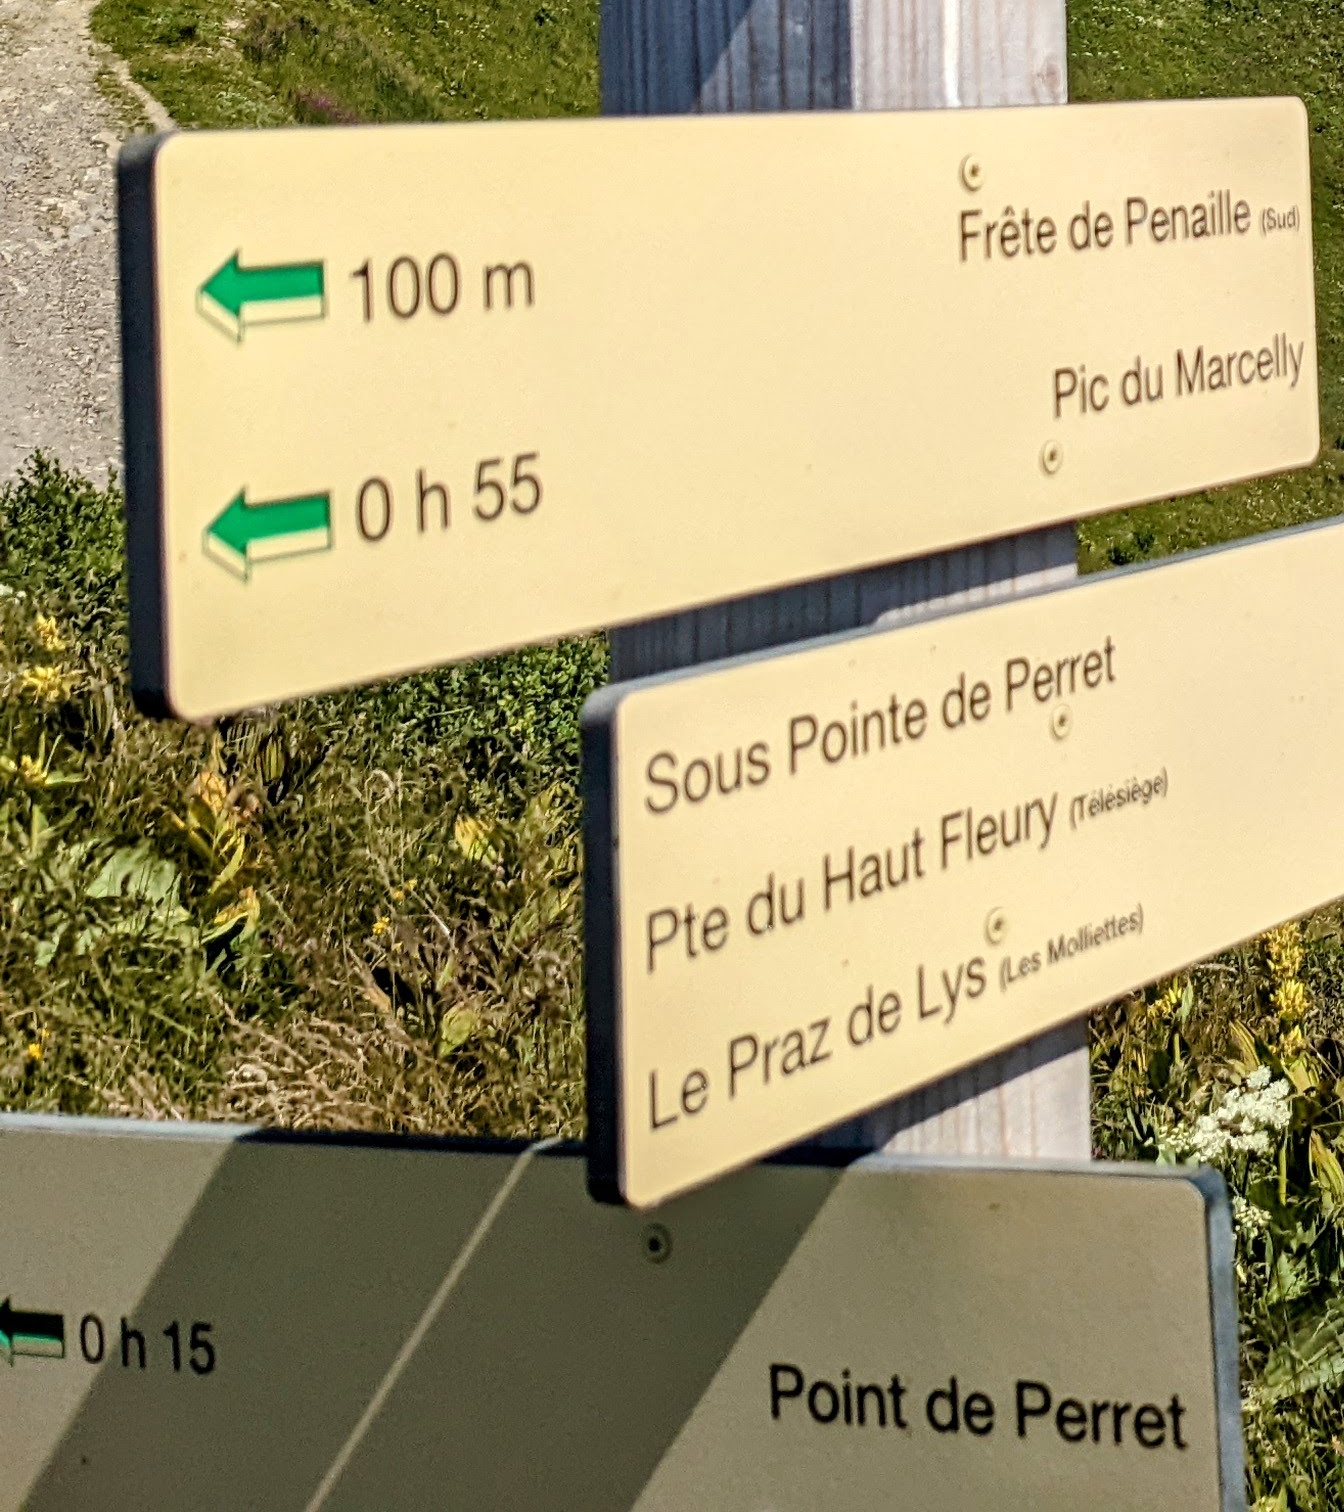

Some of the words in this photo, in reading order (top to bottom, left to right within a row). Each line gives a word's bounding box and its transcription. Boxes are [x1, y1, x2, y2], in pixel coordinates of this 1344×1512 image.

[959, 205, 1057, 263] Frête
[1069, 200, 1114, 250] de
[1125, 189, 1251, 246] Penaille
[1261, 204, 1300, 237] (Sud)
[351, 252, 460, 323] 100
[483, 259, 535, 311] m
[1053, 364, 1109, 419] Pic
[1121, 356, 1163, 407] du
[1175, 332, 1304, 397] Marcelly
[357, 476, 392, 543] 0
[417, 468, 451, 533] h
[474, 451, 543, 522] 55
[644, 740, 771, 815] Sous
[788, 694, 927, 775] Pointe
[942, 673, 992, 730] de
[1005, 635, 1117, 714] Perret
[647, 903, 729, 975] Pte
[747, 872, 806, 935] du
[822, 828, 925, 910] Haut
[940, 792, 1059, 871] Fleury
[649, 1068, 707, 1132] Le
[728, 1016, 832, 1103] Praz
[847, 984, 901, 1047] de
[917, 956, 986, 1027] Lys
[1000, 954, 1041, 992] (Les
[80, 1312, 104, 1364] 0
[121, 1315, 146, 1368] h
[163, 1320, 215, 1375] 15
[769, 1363, 908, 1429] Point
[925, 1375, 996, 1437] de
[1015, 1378, 1189, 1451] Perret
